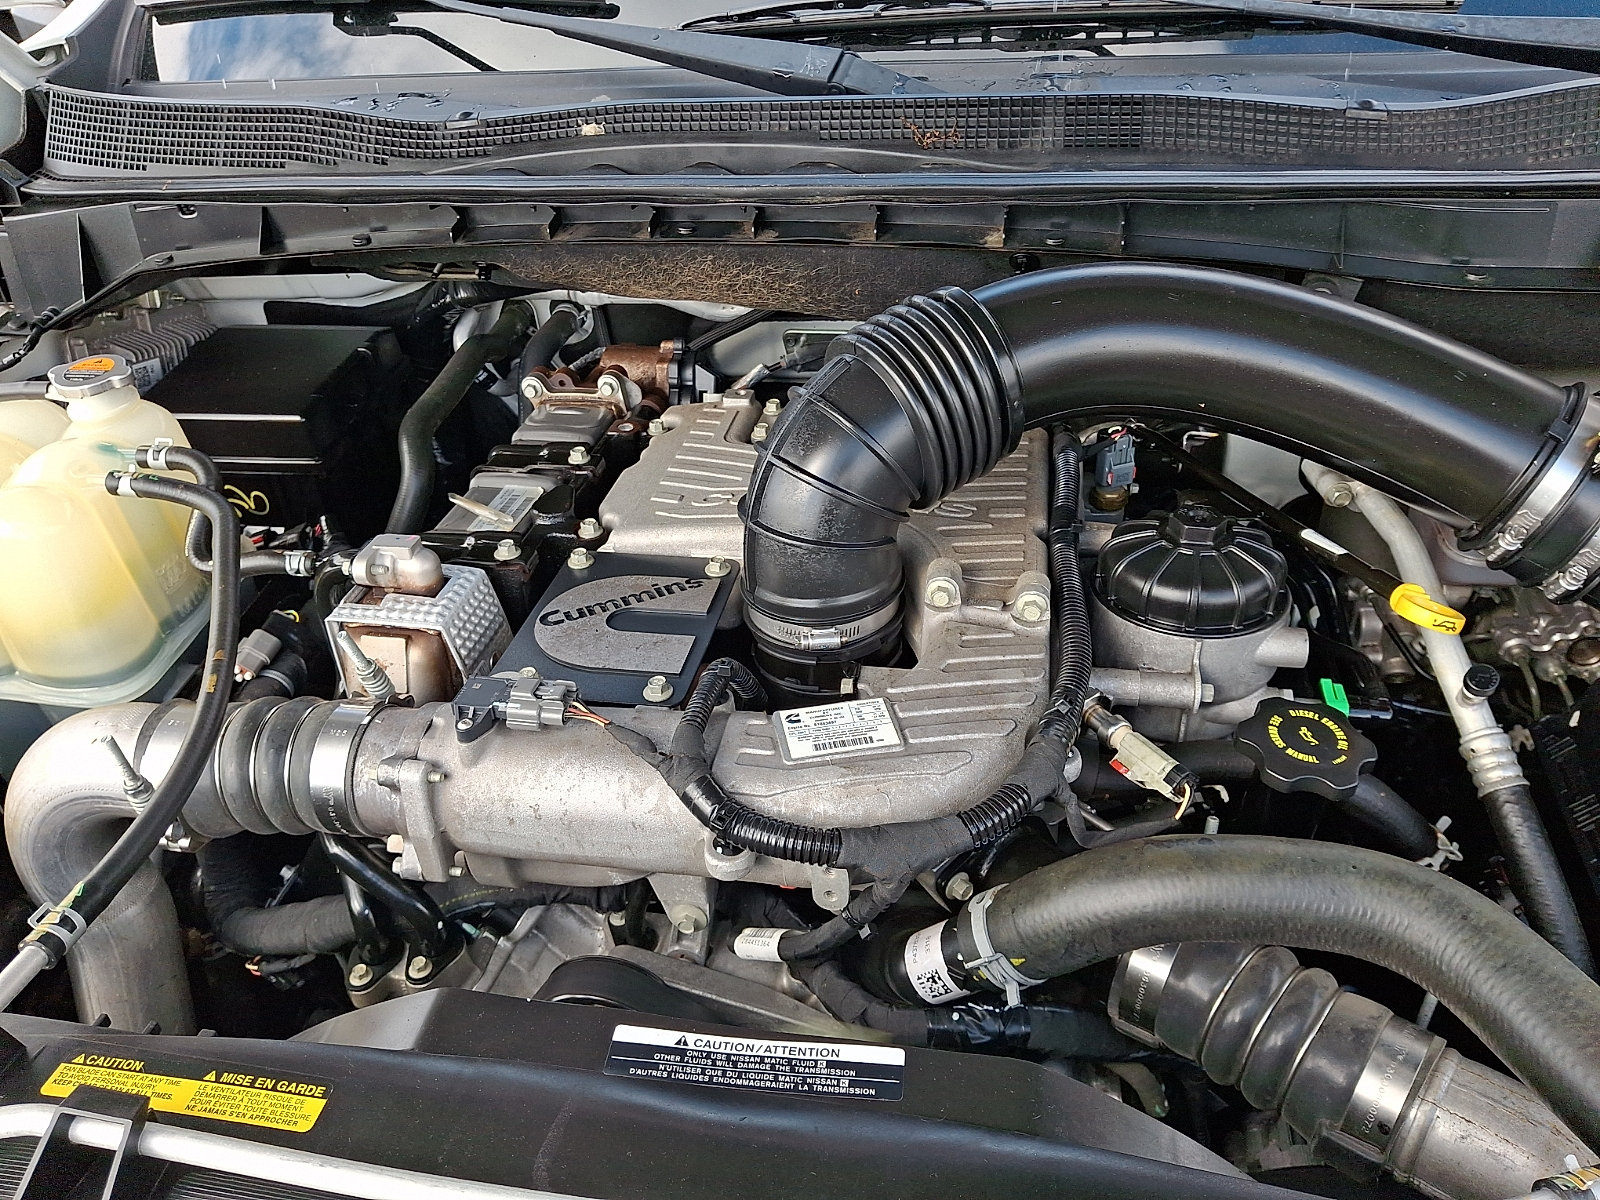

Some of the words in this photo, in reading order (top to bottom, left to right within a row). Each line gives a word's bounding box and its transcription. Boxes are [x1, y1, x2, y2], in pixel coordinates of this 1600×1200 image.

[538, 577, 704, 626] Cummins
[1269, 714, 1283, 727] SEE
[1285, 747, 1320, 764] MANUAL
[1288, 709, 1320, 720] DIESEL
[1320, 717, 1347, 740] ENGINE
[1336, 740, 1348, 750] OIL
[687, 1050, 708, 1058] ONLY
[731, 1055, 760, 1063] NISSAN
[765, 1057, 788, 1066] MATIC
[792, 1059, 815, 1067] FLUID
[693, 1038, 840, 1058] CAUTION/ATTENTION
[86, 1055, 144, 1071] CAUTION
[654, 1053, 681, 1062] OTHER
[684, 1056, 712, 1066] FLUIDS
[716, 1060, 734, 1068] WILL
[738, 1062, 771, 1071] DAMAGE
[795, 1066, 856, 1077] TRANSMISSION
[62, 1065, 77, 1074] FAN
[77, 1067, 101, 1076] BLADE
[117, 1072, 139, 1081] START
[149, 1076, 164, 1084] ANY
[68, 1073, 92, 1082] AVOID
[91, 1077, 129, 1087] PERSONAL
[220, 1072, 254, 1086] MISE
[255, 1077, 276, 1090] EN
[277, 1080, 326, 1097] GARDE
[629, 1068, 668, 1078] D'AUTRES
[671, 1072, 709, 1082] LIQUIDES
[713, 1076, 795, 1090] ENDOMMAGERAIENT
[799, 1083, 808, 1091] LA
[813, 1085, 876, 1096] TRANSMISSION
[659, 1064, 701, 1074] N'UTILISER
[742, 1072, 775, 1080] LIQUIDE
[779, 1075, 803, 1083] MATIC
[807, 1077, 838, 1086] NISSAN
[150, 1092, 173, 1100] TIMES.
[194, 1090, 237, 1102] DÉMARRER
[247, 1098, 267, 1106] TOUT
[269, 1101, 304, 1113] MOMENT.
[210, 1086, 262, 1099] VENTILATEUR
[264, 1094, 294, 1104] RISQUE
[189, 1097, 213, 1106] POUR
[243, 1104, 269, 1115] TOUTE
[198, 1106, 227, 1116] JAMAIS
[228, 1110, 247, 1119] S'EN
[248, 1113, 299, 1127] APPROCHER
